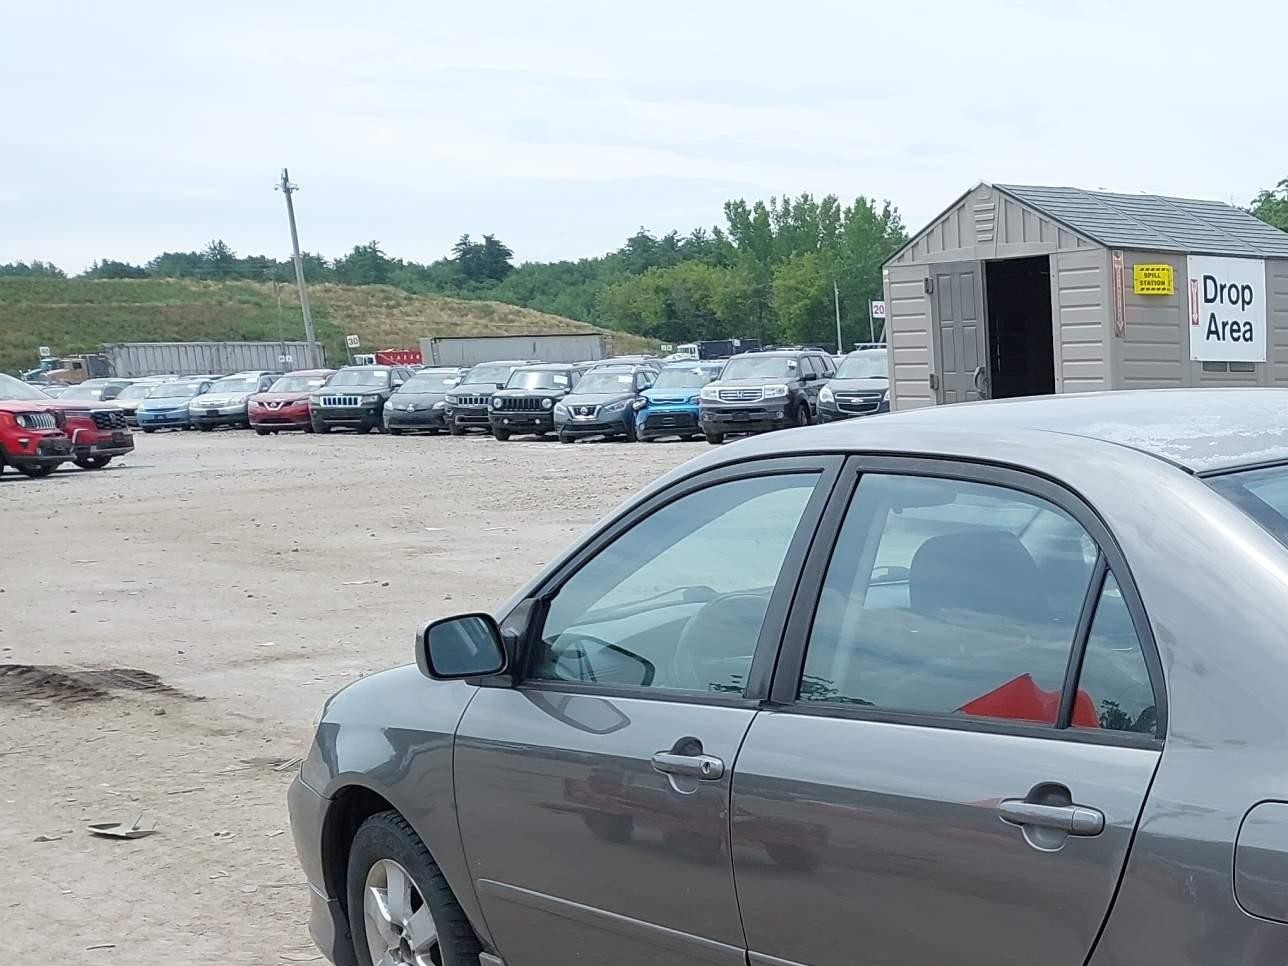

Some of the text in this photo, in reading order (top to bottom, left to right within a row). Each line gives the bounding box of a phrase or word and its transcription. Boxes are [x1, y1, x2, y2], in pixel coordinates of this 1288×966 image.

[1203, 275, 1253, 311] Drop
[873, 304, 885, 315] 20
[1206, 312, 1253, 342] Area
